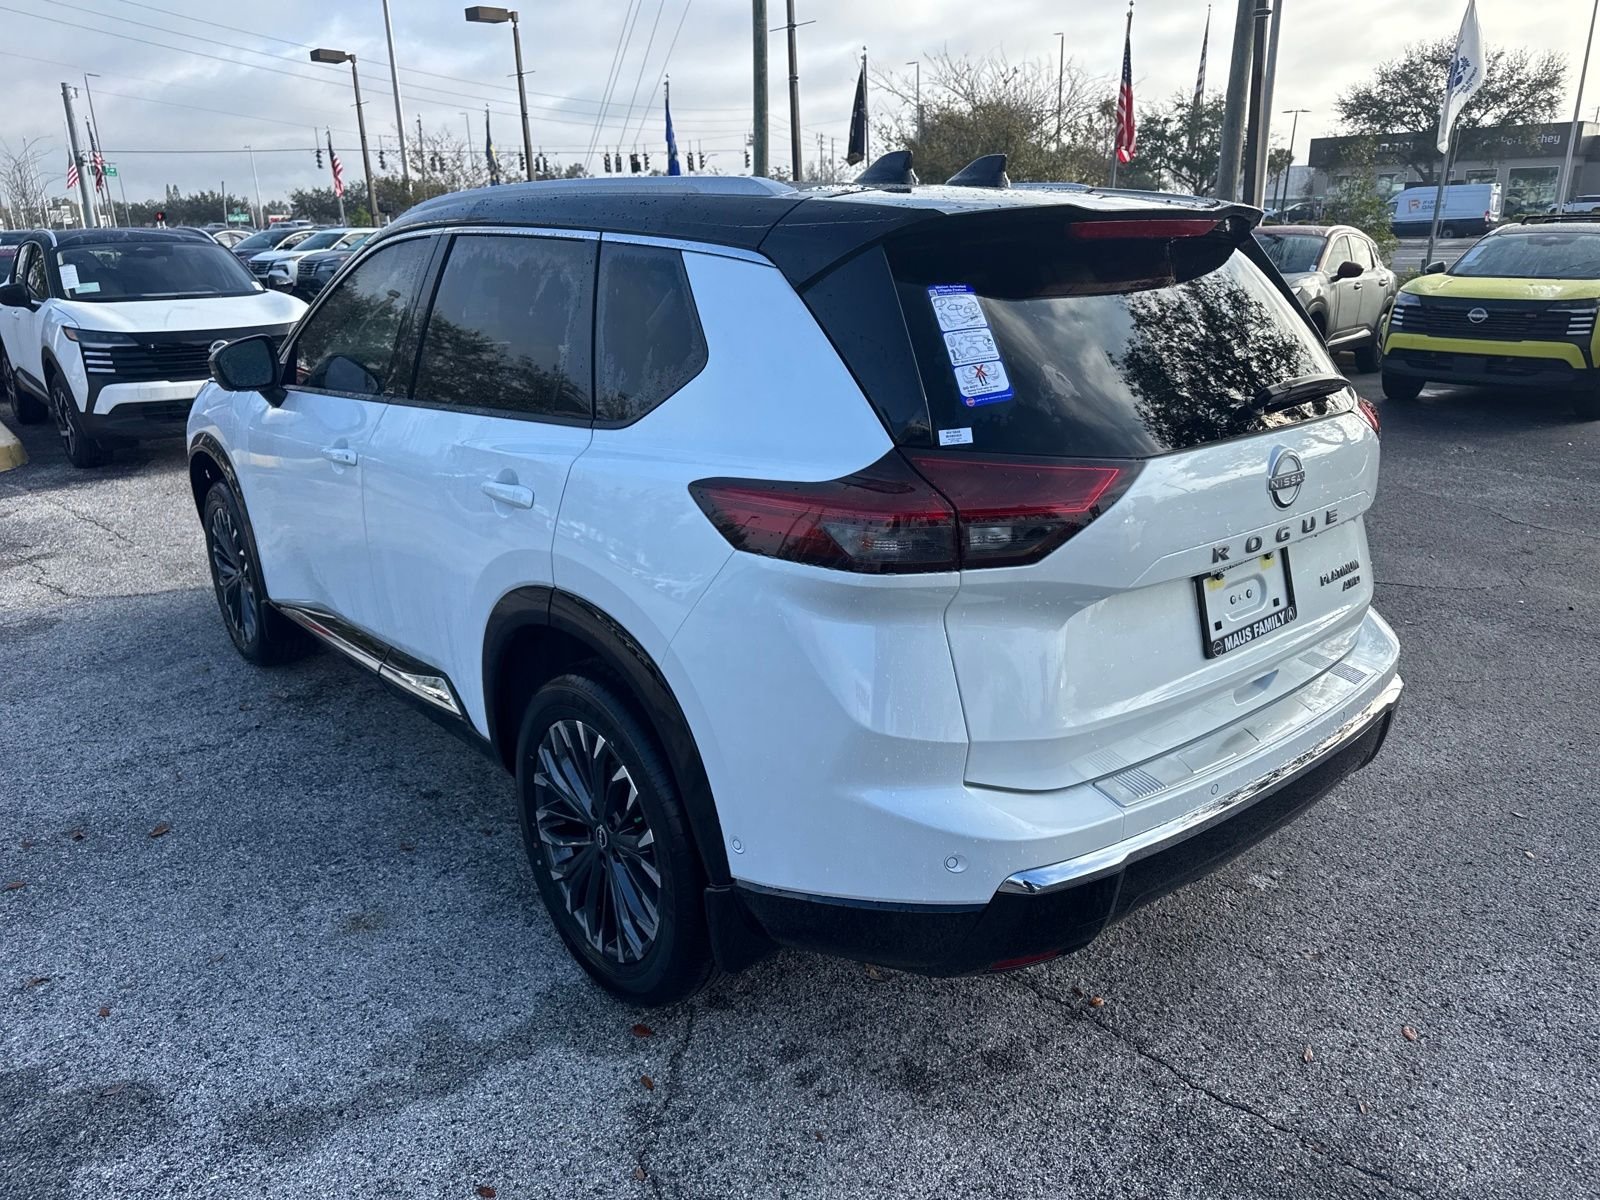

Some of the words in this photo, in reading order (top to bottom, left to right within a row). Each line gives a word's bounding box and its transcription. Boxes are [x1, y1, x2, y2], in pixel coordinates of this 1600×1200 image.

[1271, 470, 1305, 489] NISSAN
[1212, 508, 1338, 564] ROGUE
[1319, 558, 1360, 587] PLATINUM
[1342, 575, 1361, 592] AWD
[1224, 626, 1252, 652] MAUS
[1253, 610, 1285, 638] FAMILY
